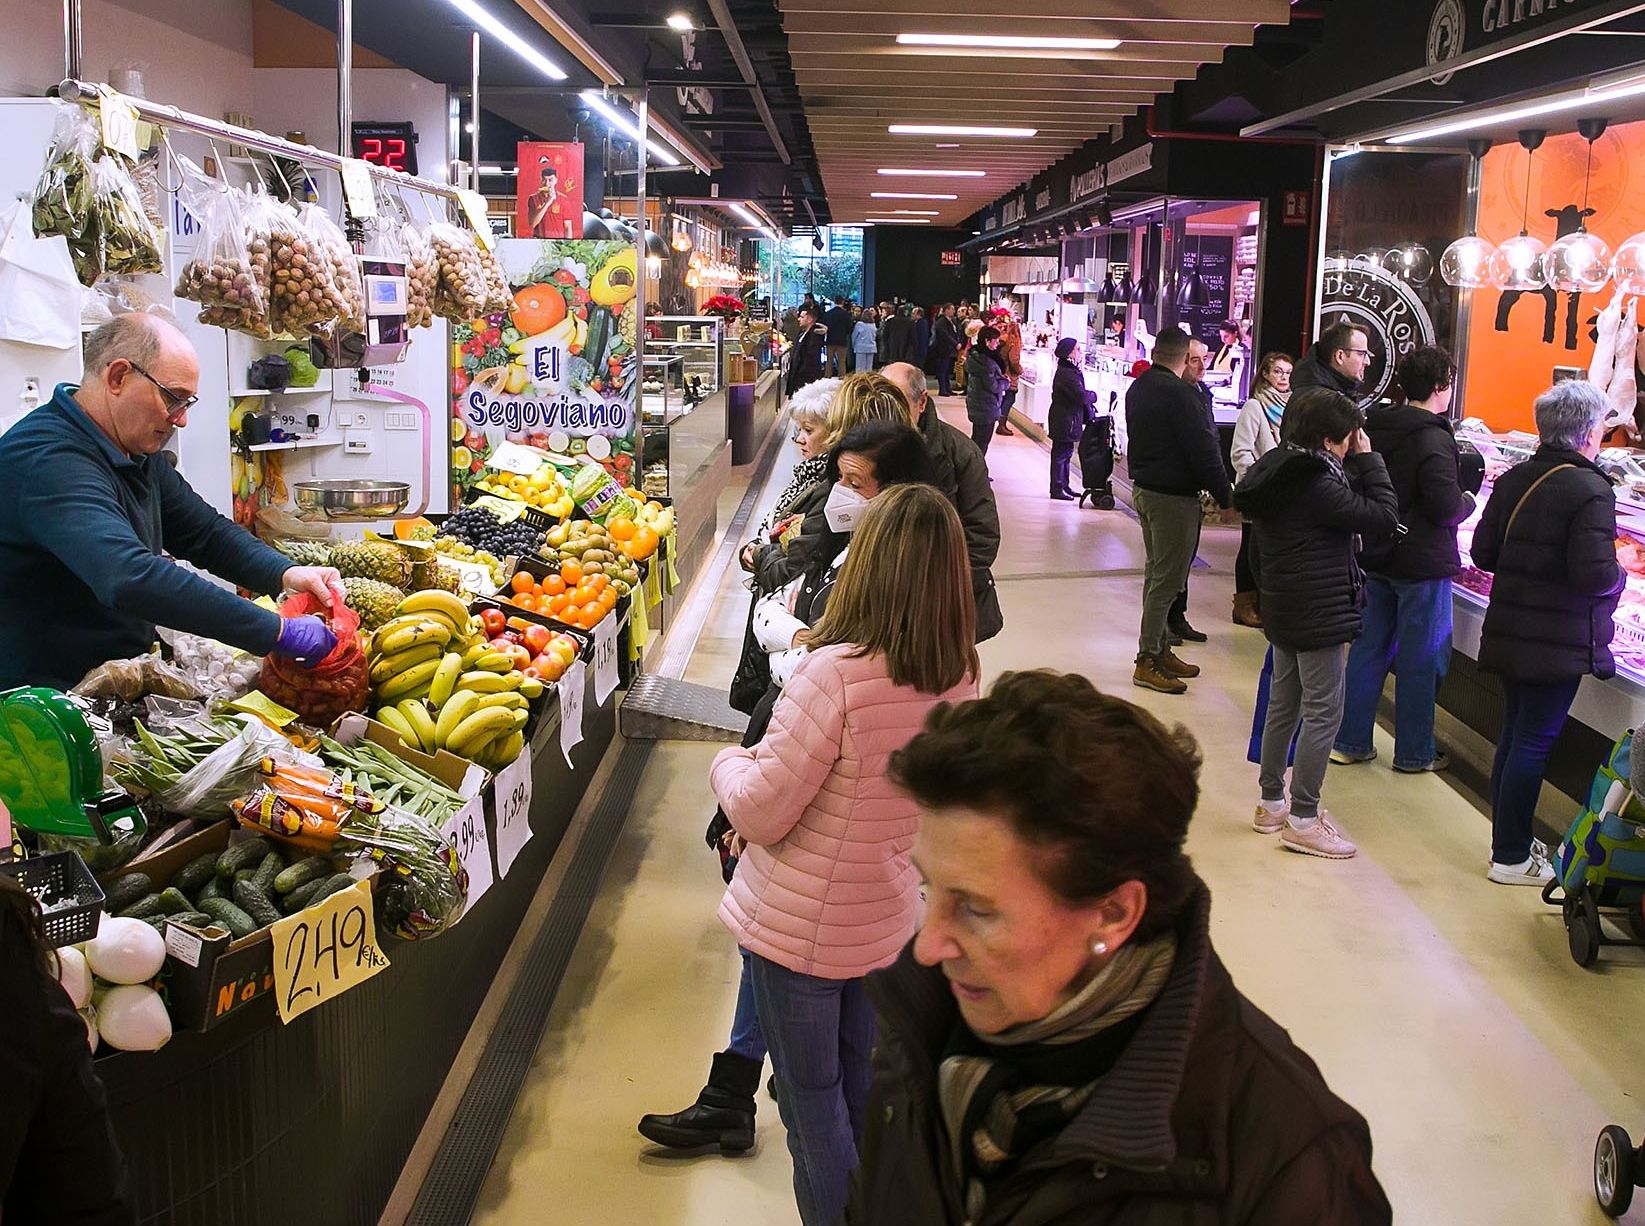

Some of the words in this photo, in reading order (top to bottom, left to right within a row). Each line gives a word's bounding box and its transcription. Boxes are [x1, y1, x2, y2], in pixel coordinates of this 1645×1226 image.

[361, 139, 406, 170] 22
[1324, 277, 1354, 296] De
[1356, 283, 1381, 308] La
[1381, 296, 1416, 355] Ros
[533, 346, 560, 382] El
[467, 391, 627, 432] Segoviano
[285, 904, 366, 1013] 2,49
